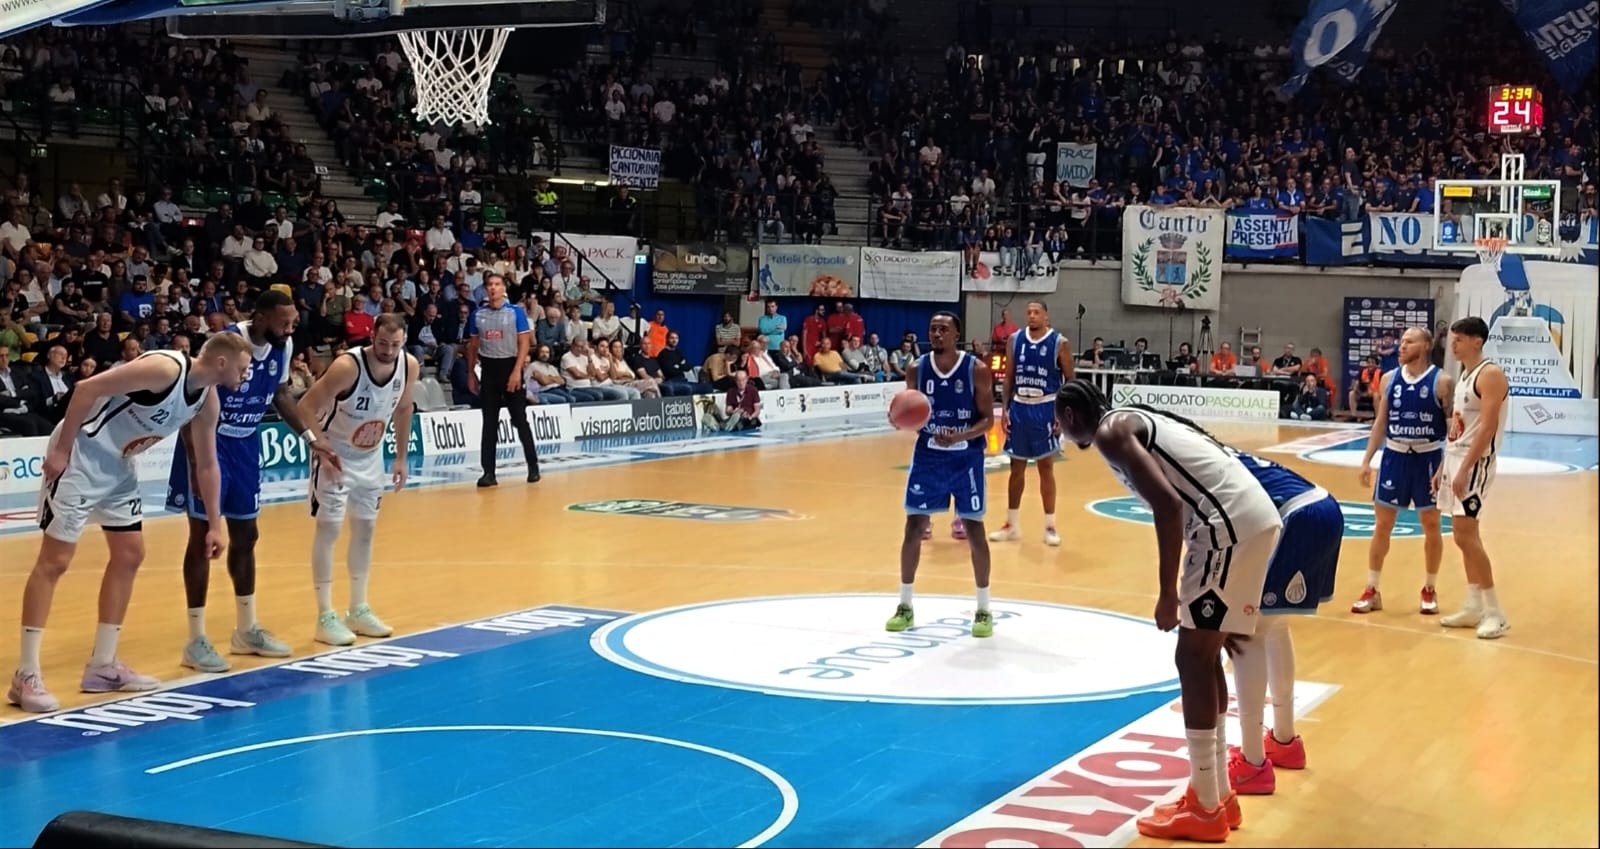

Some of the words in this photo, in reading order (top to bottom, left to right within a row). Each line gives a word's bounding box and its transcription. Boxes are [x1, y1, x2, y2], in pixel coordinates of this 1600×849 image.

[1502, 87, 1532, 100] 3:39
[1494, 101, 1530, 124] 24
[611, 146, 660, 162] PICCIONAIA
[611, 160, 660, 175] CANTURINA
[1235, 218, 1292, 233] ASSENTI
[1379, 215, 1421, 245] NO
[1231, 230, 1294, 246] PRESENTI
[685, 252, 718, 265] unico
[1488, 334, 1551, 344] PAPARELLI
[1532, 358, 1559, 367] TUBI
[1515, 367, 1550, 375] POZZI
[1393, 384, 1402, 399] 3
[356, 396, 370, 411] 21
[665, 400, 692, 415] cabine
[150, 409, 170, 425] 22
[666, 414, 693, 429] doccia
[531, 408, 561, 442] tabu
[431, 416, 466, 450] tabu
[279, 645, 462, 677] tabu
[37, 692, 257, 733] tabu
